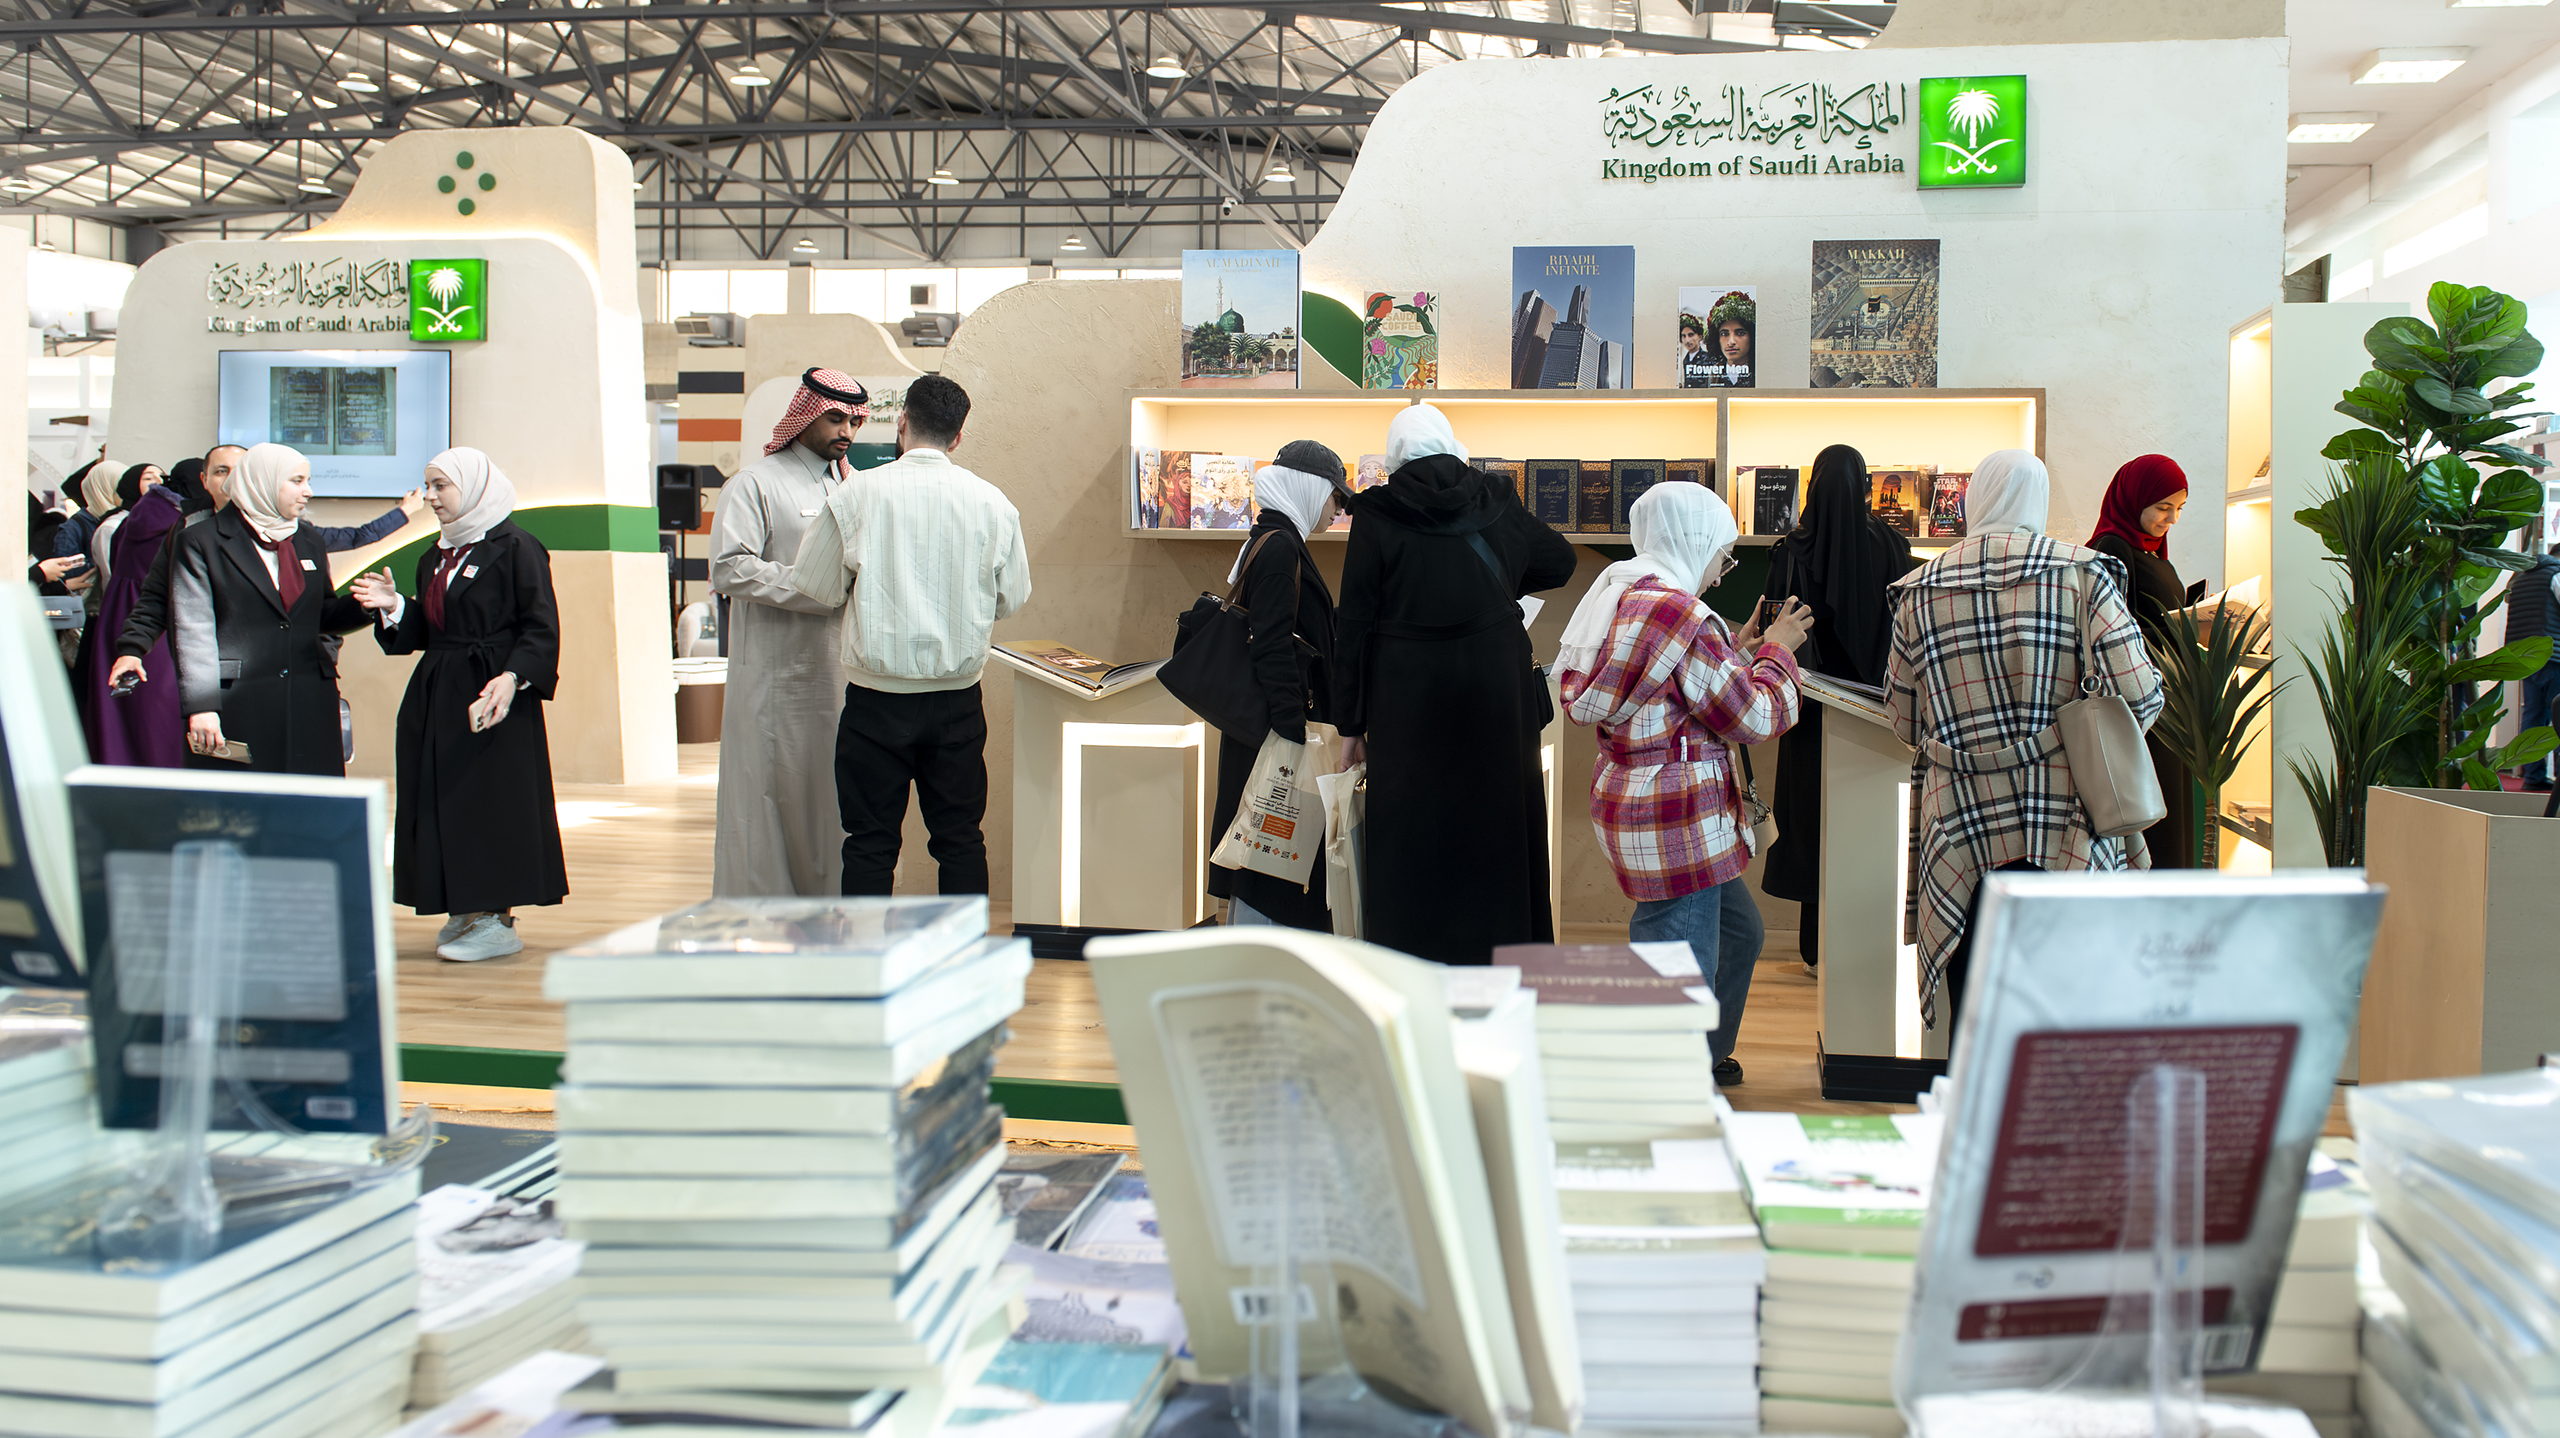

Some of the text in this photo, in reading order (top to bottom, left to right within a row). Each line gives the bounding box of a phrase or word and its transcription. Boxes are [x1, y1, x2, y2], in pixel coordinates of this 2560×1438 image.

[1599, 82, 1906, 149] المملكة العربية السعودية
[1602, 153, 1905, 183] Kingdom of Saudi Arabia
[1847, 248, 1905, 259] MAKKAH
[1222, 255, 1280, 268] MADINAH
[1549, 255, 1595, 265] RIYADH
[1546, 265, 1600, 275] INFINITE
[1386, 312, 1416, 321] SAUDI
[207, 315, 411, 336] Kingdom of Saudi Arabia
[1382, 321, 1421, 331] COFFEE
[1686, 363, 1749, 375] Flower Men
